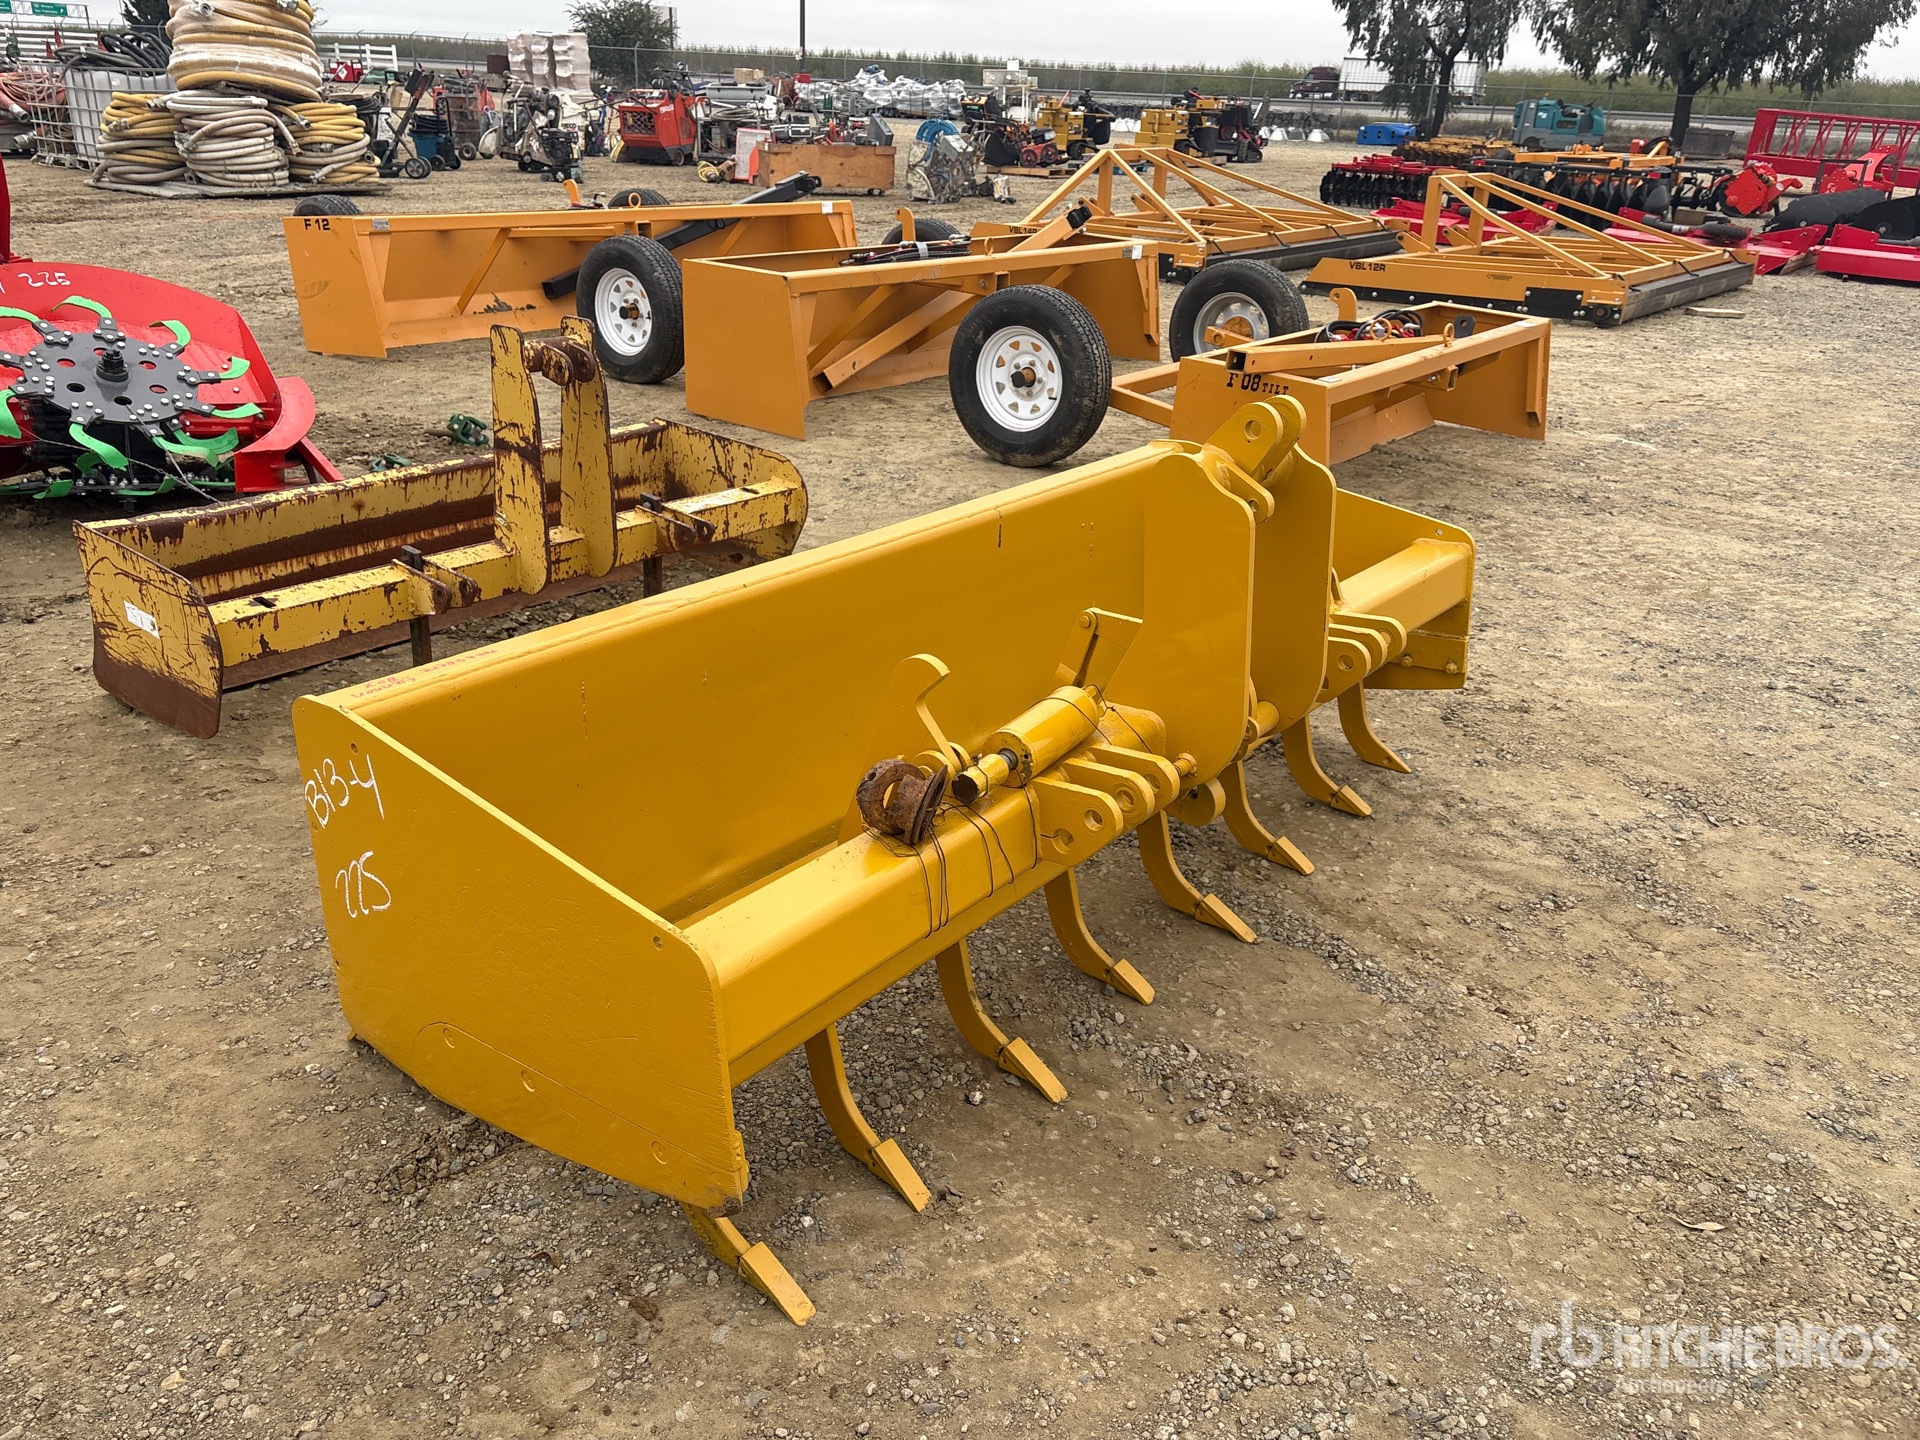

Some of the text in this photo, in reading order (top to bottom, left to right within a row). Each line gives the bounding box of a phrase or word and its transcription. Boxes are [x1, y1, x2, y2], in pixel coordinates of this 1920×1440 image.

[304, 219, 330, 230] F 12
[1349, 262, 1386, 272] VBL12R
[17, 271, 71, 287] 225
[1226, 372, 1289, 395] F 08 TILT
